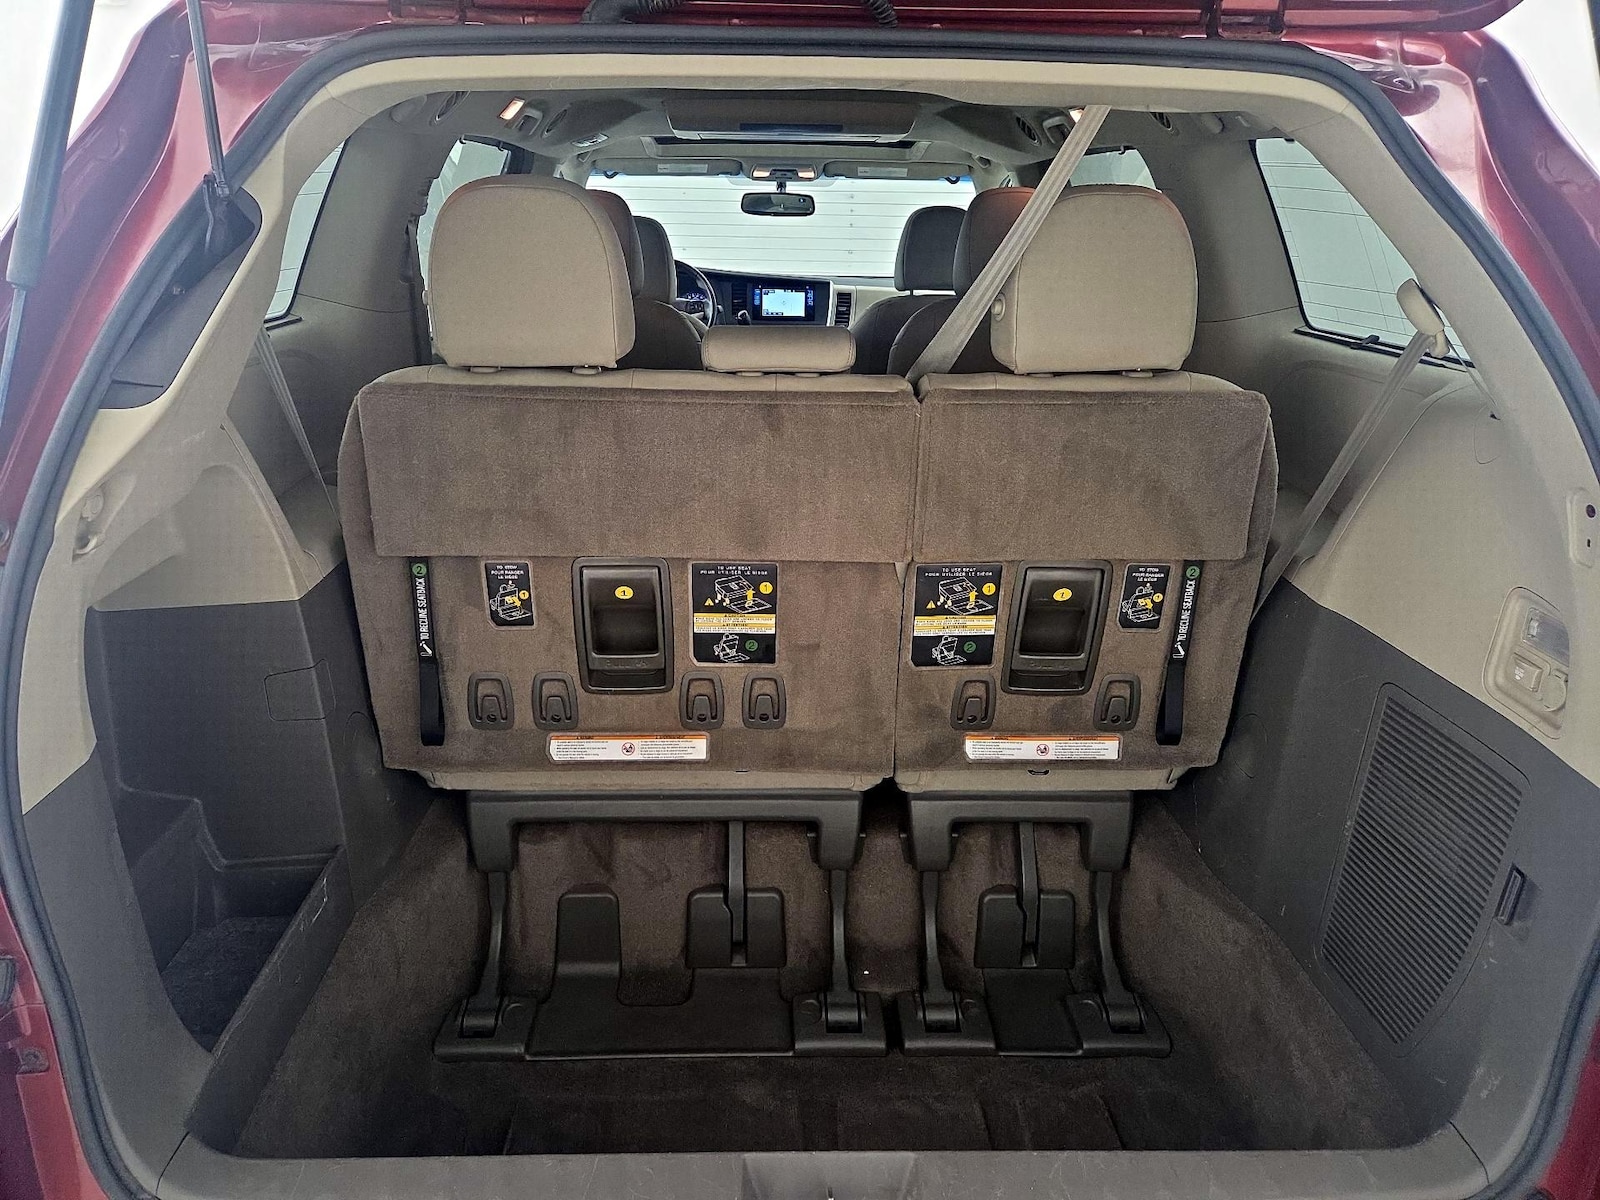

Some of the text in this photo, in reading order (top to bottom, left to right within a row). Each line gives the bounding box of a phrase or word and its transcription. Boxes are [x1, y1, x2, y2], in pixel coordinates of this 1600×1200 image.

[415, 577, 430, 640] TO RECLINE SEATBACK
[1176, 580, 1196, 641] TO RECLINE SEATBACK
